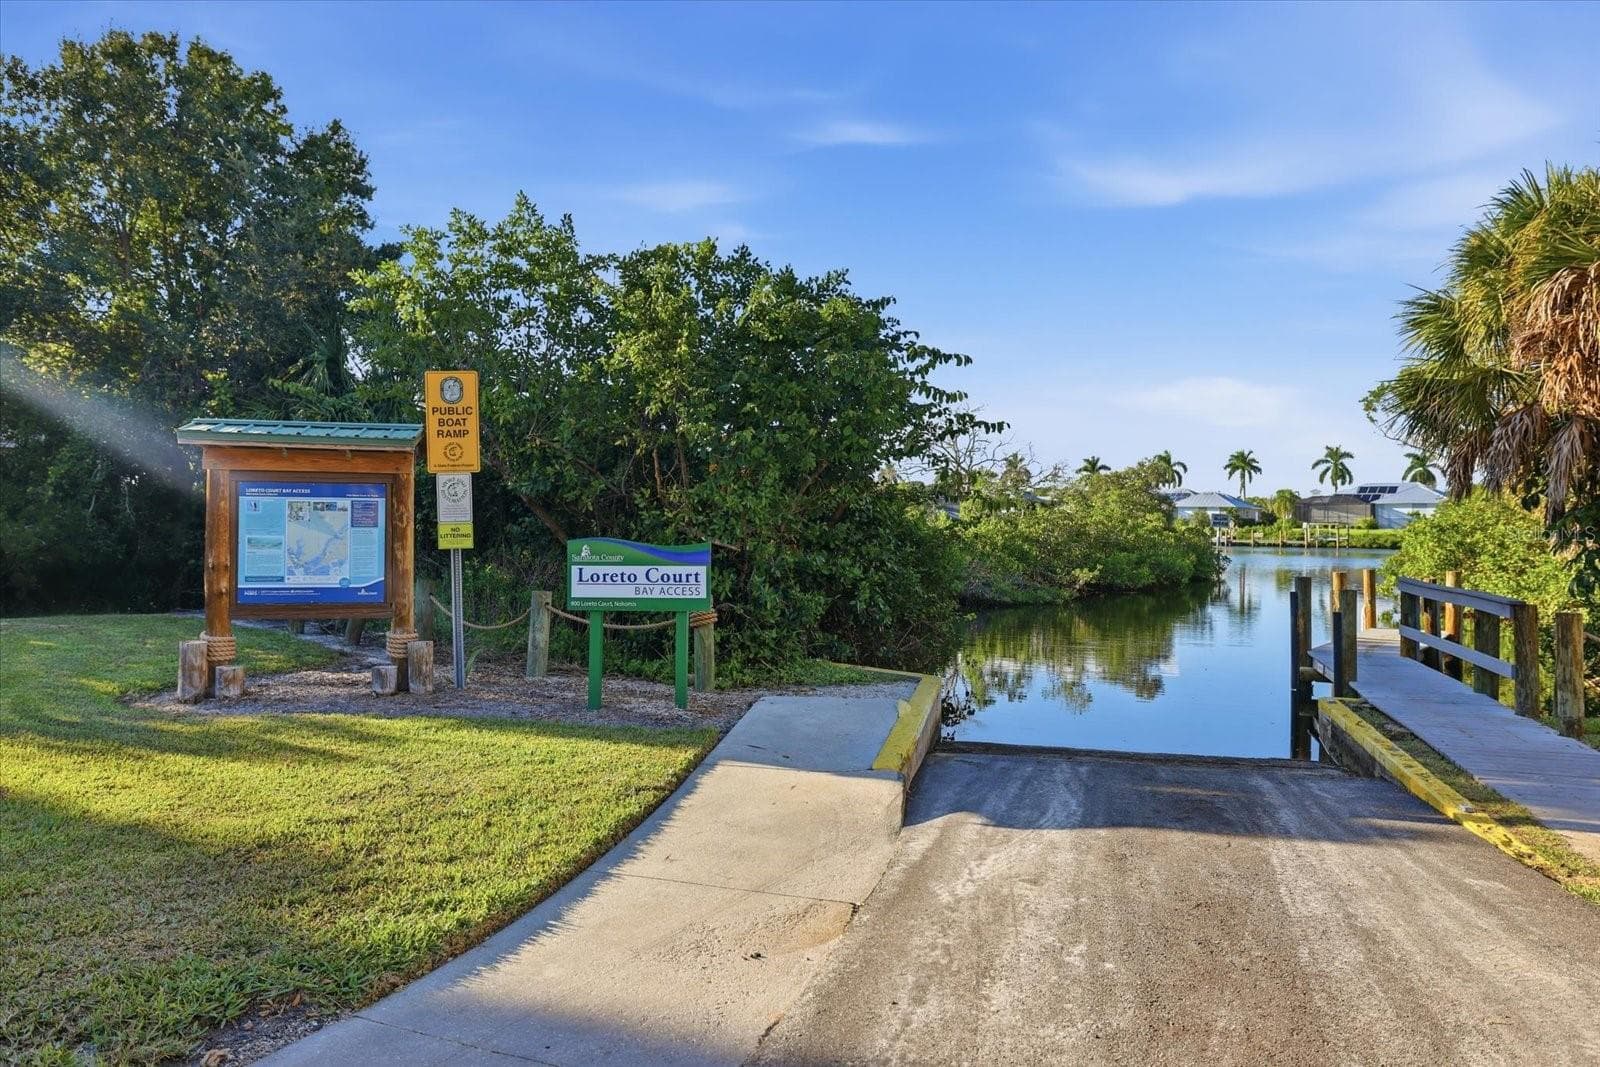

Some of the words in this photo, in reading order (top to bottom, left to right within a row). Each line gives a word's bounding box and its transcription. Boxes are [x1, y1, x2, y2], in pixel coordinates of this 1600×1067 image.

[431, 406, 473, 416] PUBLIC
[437, 418, 468, 427] BOAT
[436, 429, 470, 439] RAMP
[577, 567, 638, 583] Loreto
[645, 567, 701, 583] Court
[634, 586, 655, 596] BAY
[660, 586, 701, 596] ACCESS
